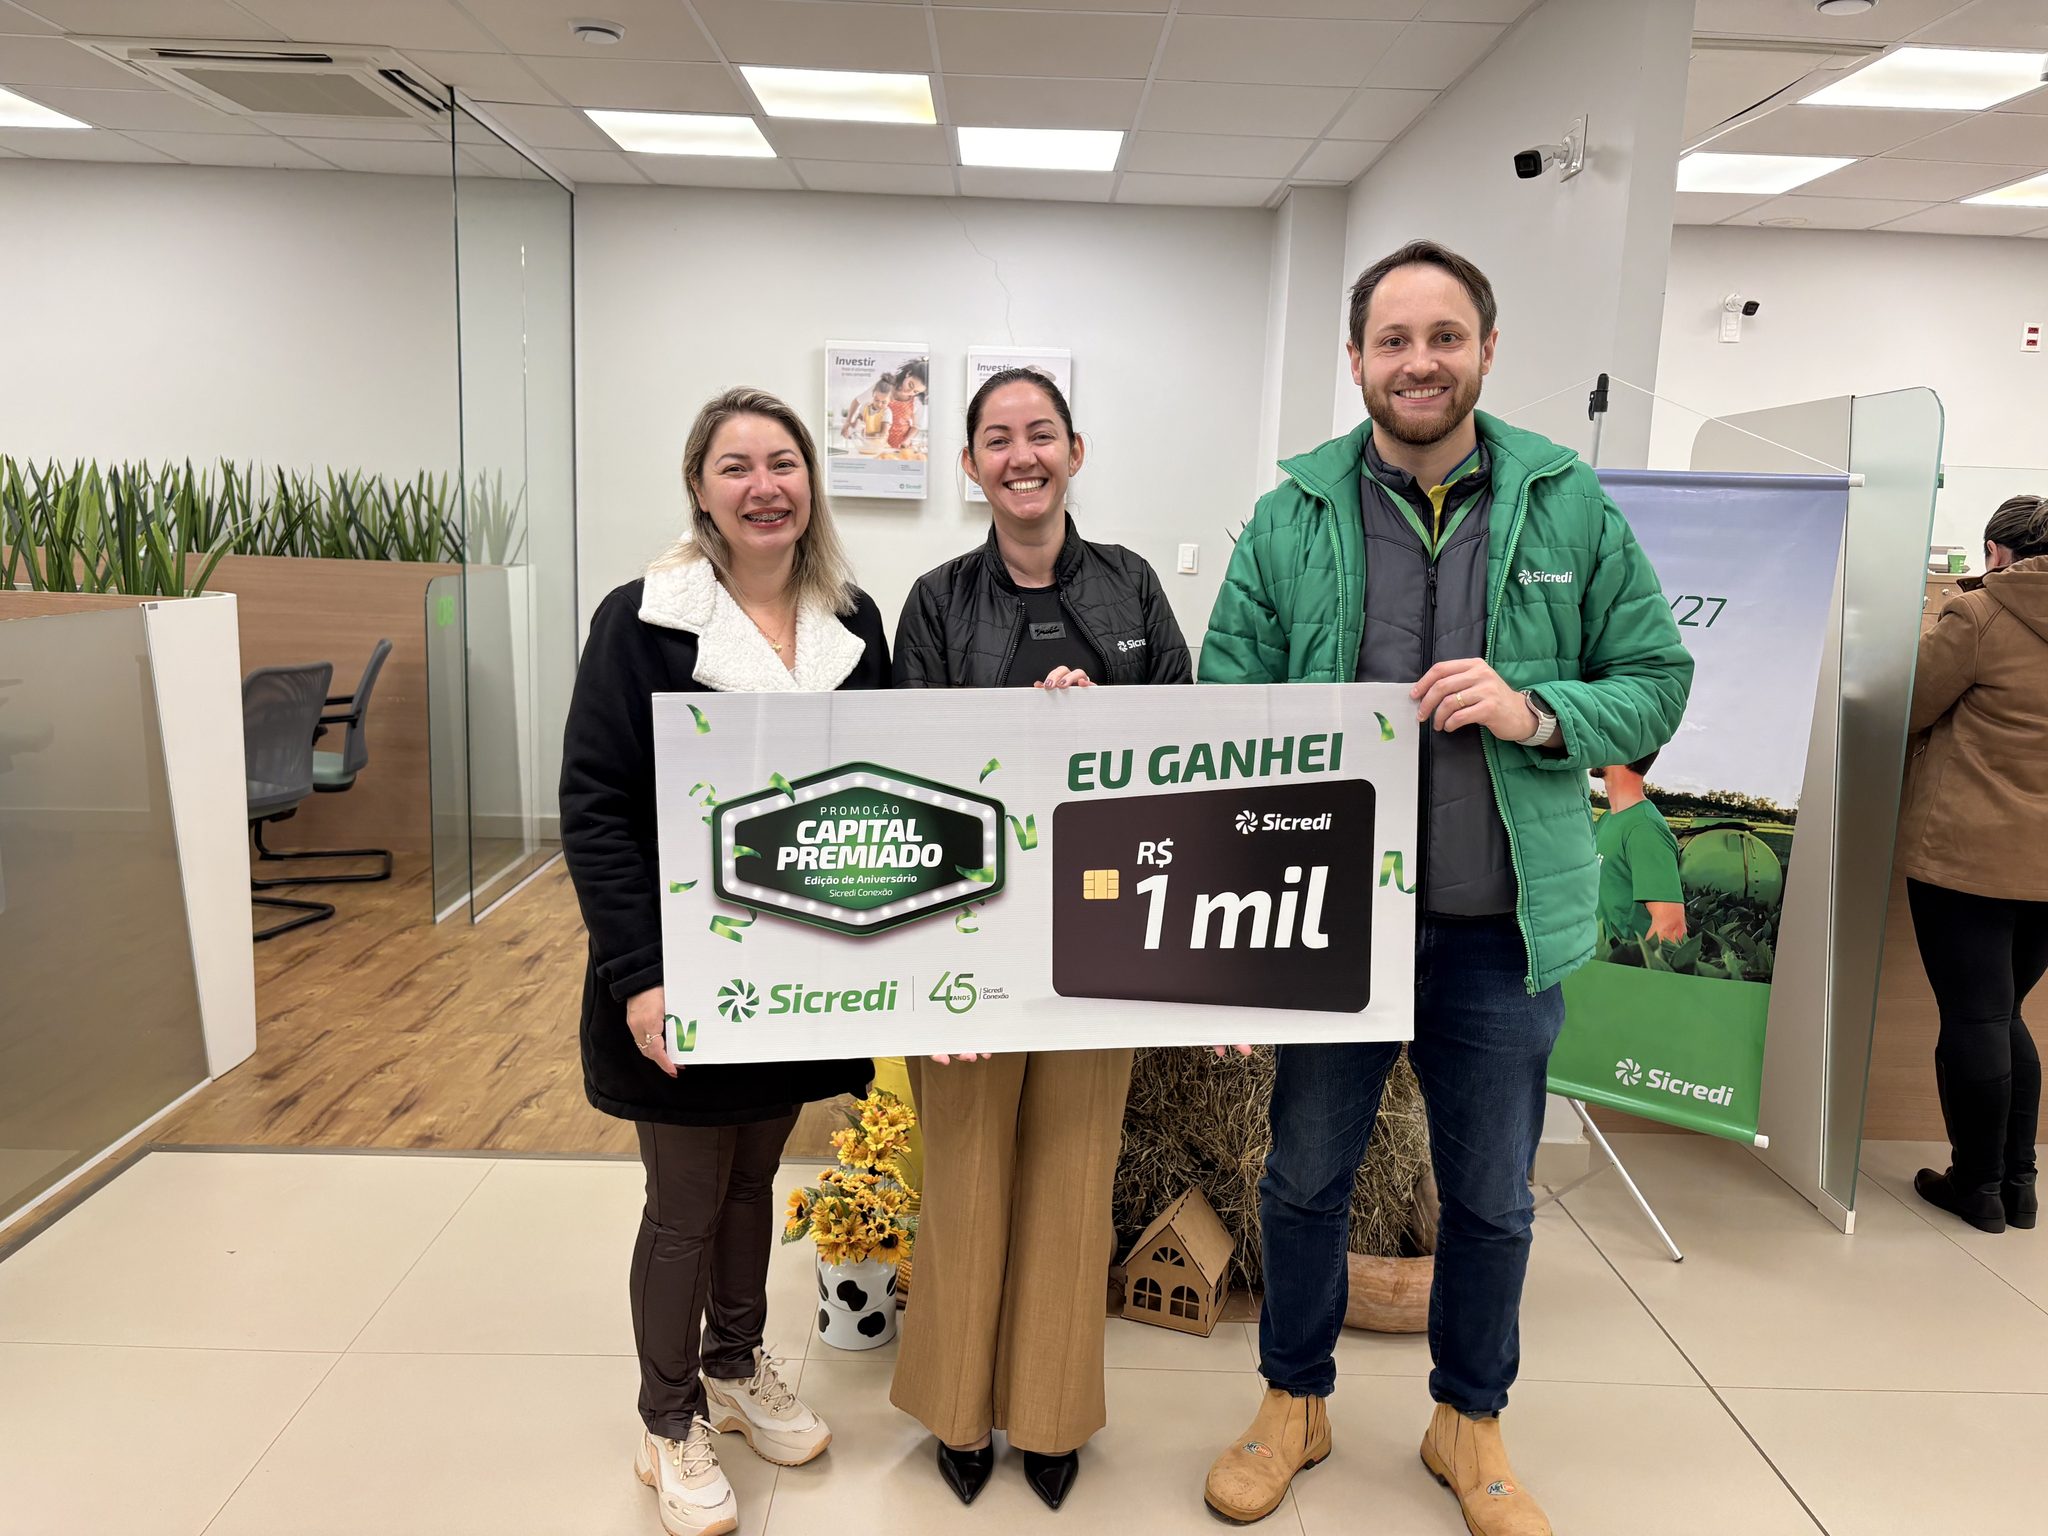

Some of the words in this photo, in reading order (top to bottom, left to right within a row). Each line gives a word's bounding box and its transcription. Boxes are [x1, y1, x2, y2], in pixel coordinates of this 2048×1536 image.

[835, 356, 876, 366] Investir
[977, 363, 1014, 371] Investir
[1532, 571, 1573, 583] Sicredi
[1067, 749, 1133, 792] EU
[1148, 732, 1344, 785] GANHEI
[820, 803, 900, 818] PROMOÇÃO
[1261, 813, 1332, 831] Sicredi
[796, 818, 923, 845] CAPITAL
[776, 843, 943, 871] PREMIADO
[1136, 838, 1174, 868] R$
[804, 875, 839, 887] Edição
[842, 875, 855, 884] de
[857, 873, 918, 884] Aniversário
[829, 888, 857, 898] Sicredi
[858, 888, 893, 898] Conexão
[1136, 874, 1169, 949] 1
[1189, 865, 1329, 949] mil
[768, 981, 898, 1014] Sicredi
[928, 971, 977, 1014] 45
[1646, 1068, 1734, 1107] Sicredi
